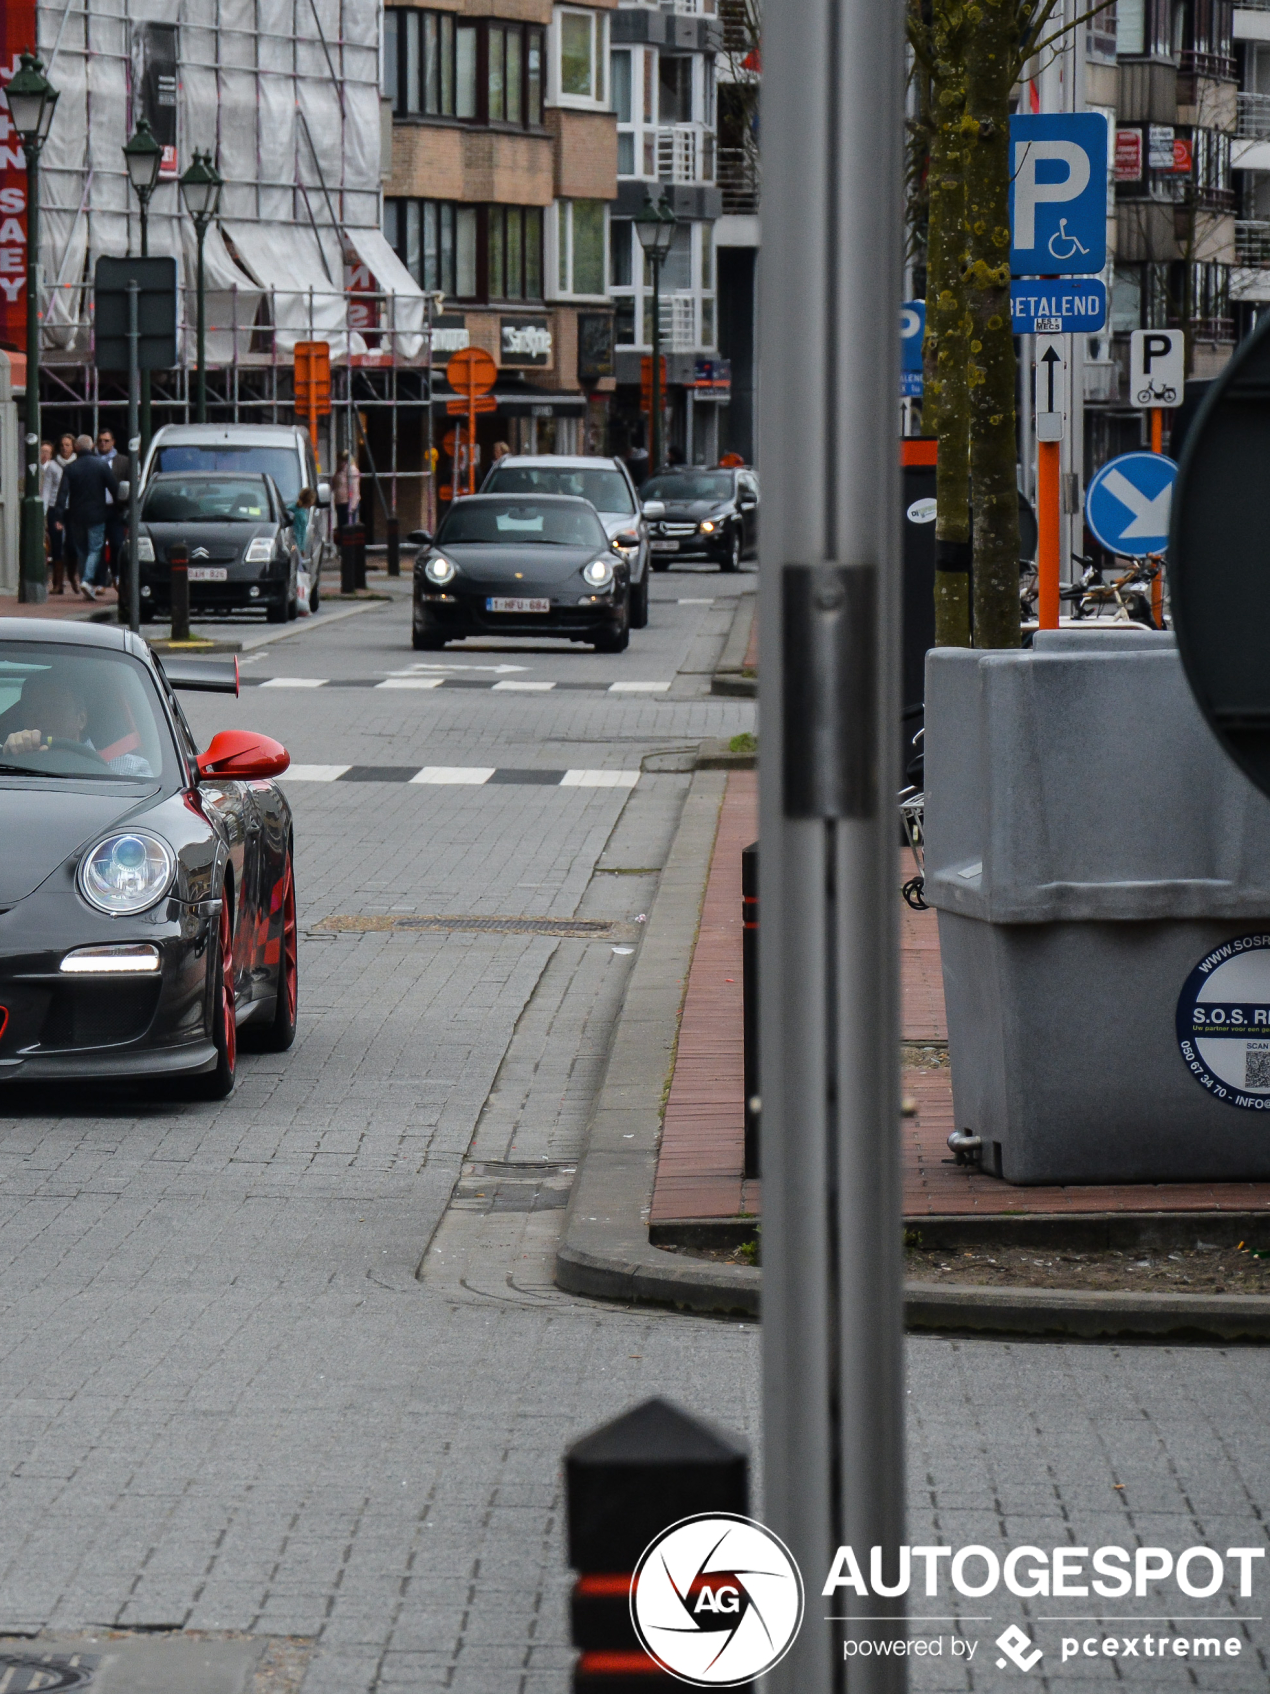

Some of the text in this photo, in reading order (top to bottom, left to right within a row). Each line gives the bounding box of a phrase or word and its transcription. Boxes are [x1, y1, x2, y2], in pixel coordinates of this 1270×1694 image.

[1014, 140, 1091, 250] P
[1143, 334, 1172, 374] P
[1198, 935, 1270, 973] WWW.SOSR
[1193, 1008, 1248, 1024] S.O.S.
[1180, 1040, 1196, 1062] 050
[1190, 1060, 1204, 1075] 67
[1200, 1074, 1215, 1089] 34
[1213, 1086, 1228, 1099] 70
[1235, 1095, 1270, 1109] INFO@
